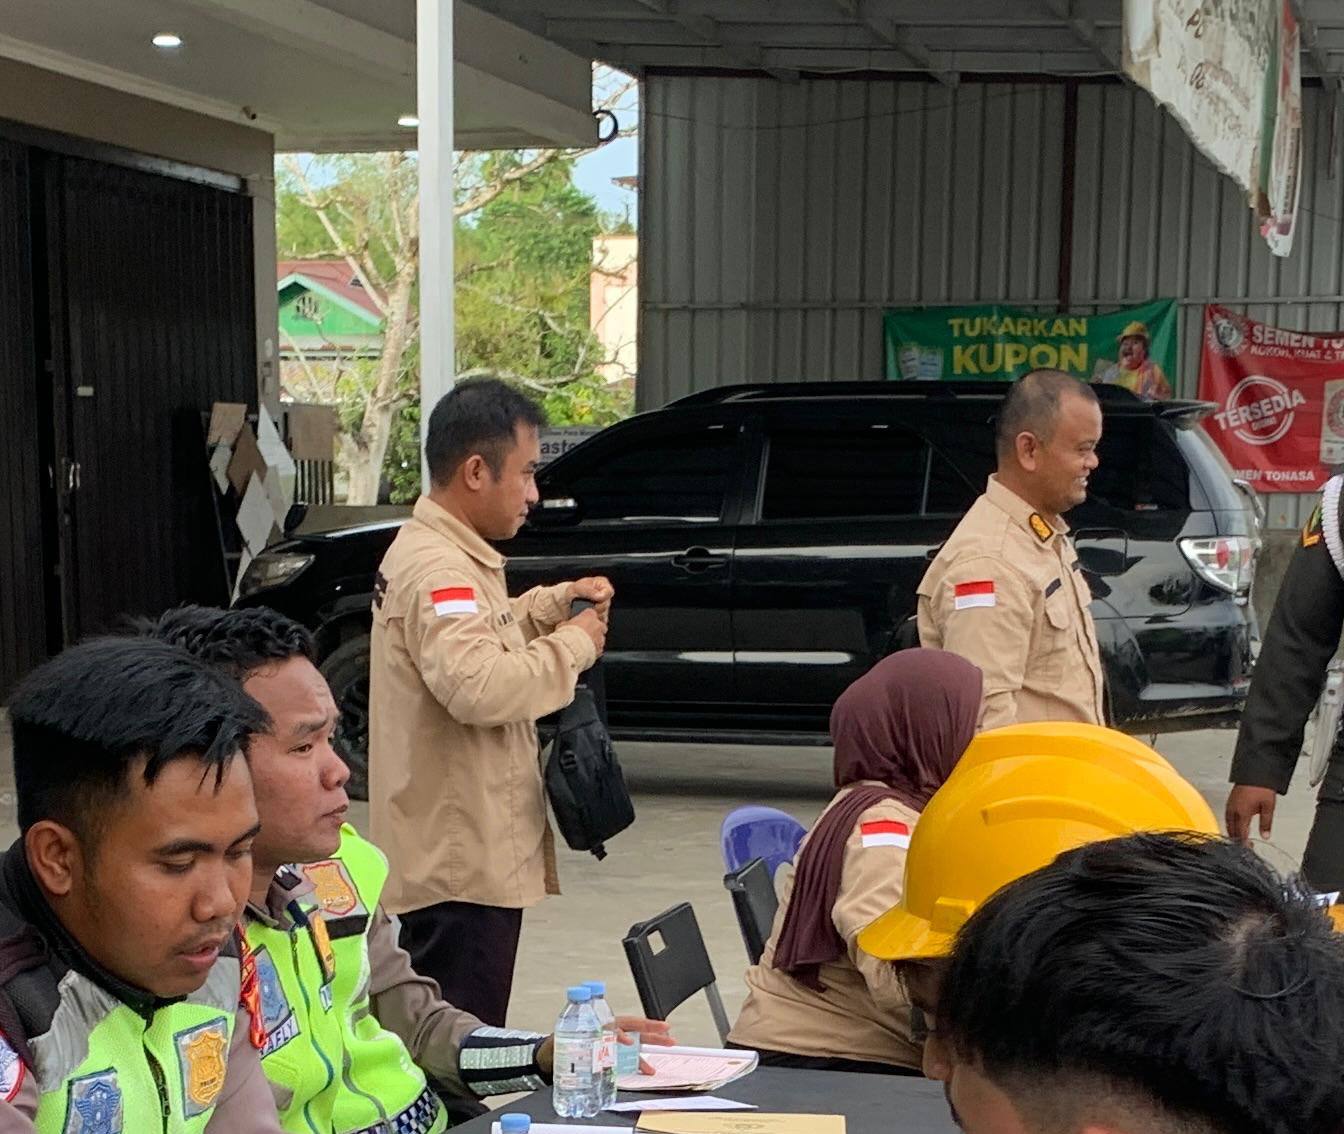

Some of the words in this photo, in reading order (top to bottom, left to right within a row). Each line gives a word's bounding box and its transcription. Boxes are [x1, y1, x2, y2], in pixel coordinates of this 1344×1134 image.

[948, 317, 1087, 337] TUKARKAN
[1252, 325, 1315, 348] SEMEN
[953, 343, 1088, 375] KUPON
[1214, 389, 1306, 431] TERSEDIA
[1264, 470, 1315, 481] TONASA
